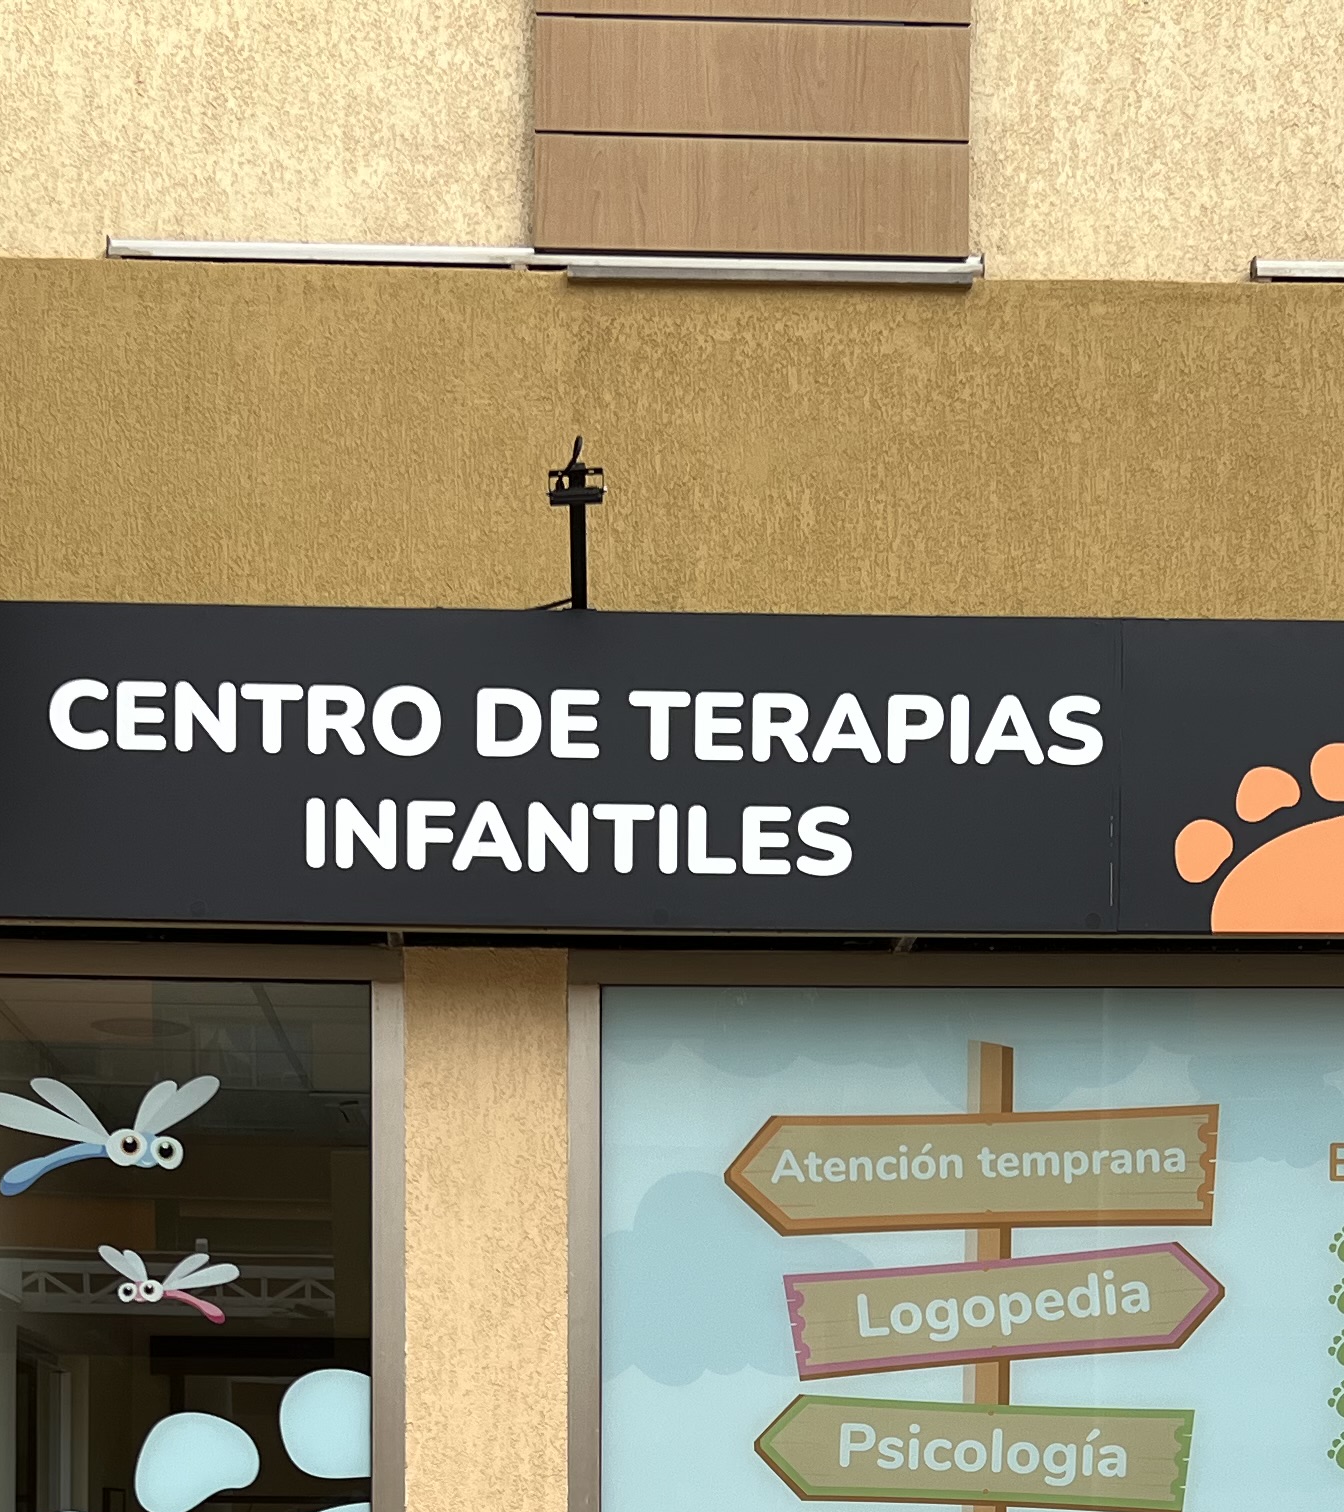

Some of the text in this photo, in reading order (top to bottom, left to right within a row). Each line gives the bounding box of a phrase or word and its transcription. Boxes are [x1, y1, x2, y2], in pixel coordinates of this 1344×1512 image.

[48, 678, 1105, 766] CENTRO DE TERAPIAS
[304, 798, 854, 877] INFANTILES
[769, 1142, 1187, 1185] Atención temprana
[856, 1270, 1151, 1342] Logopedia
[838, 1422, 1128, 1486] Psicología
